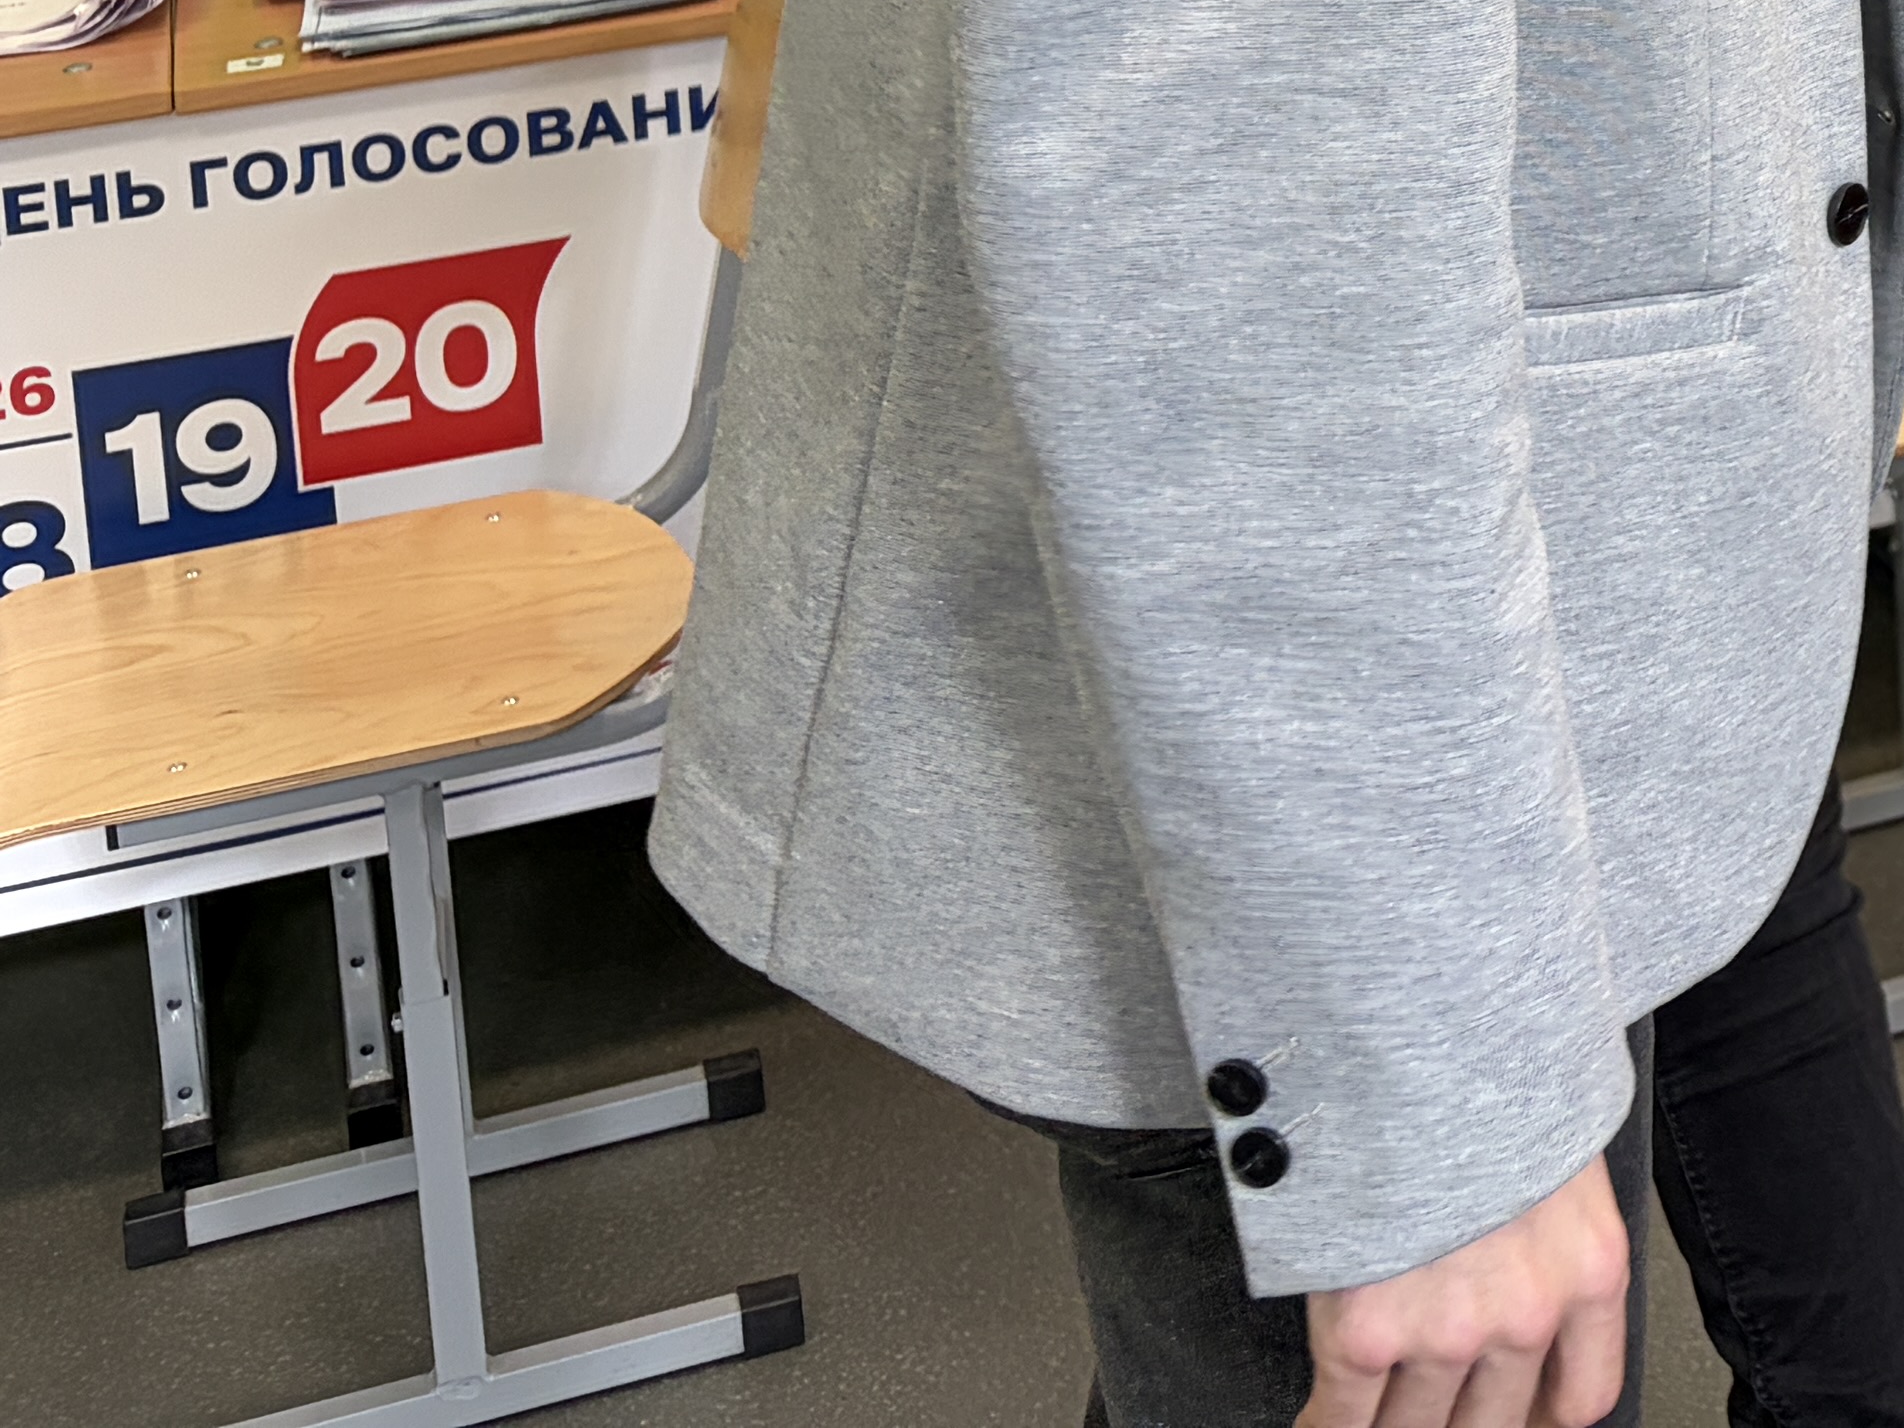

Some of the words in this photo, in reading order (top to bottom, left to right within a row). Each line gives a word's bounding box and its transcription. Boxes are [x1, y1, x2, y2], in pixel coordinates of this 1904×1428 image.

[1, 169, 166, 237] ЕНЬ
[189, 84, 719, 210] ГОЛОСОВАНИ
[312, 299, 518, 437] 20
[103, 399, 279, 526] 19
